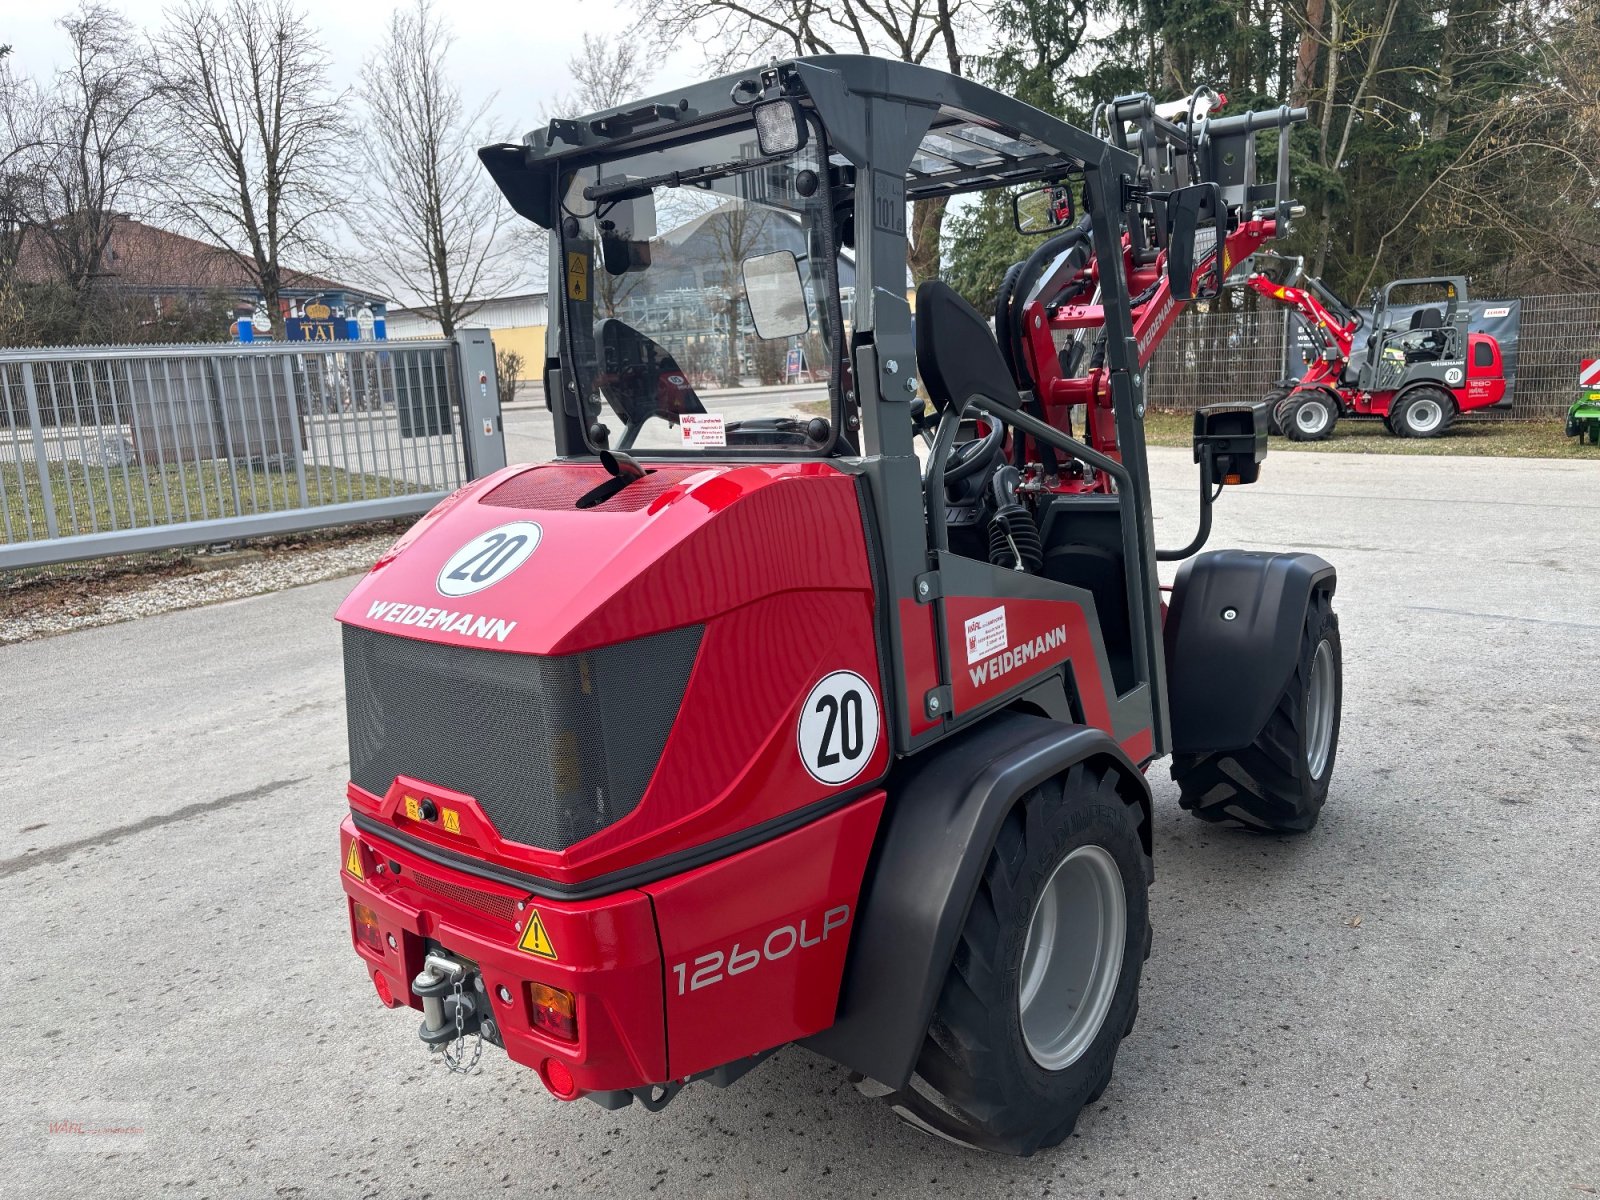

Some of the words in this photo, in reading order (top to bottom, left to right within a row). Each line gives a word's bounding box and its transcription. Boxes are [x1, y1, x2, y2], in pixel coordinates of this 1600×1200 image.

[877, 196, 894, 230] 101
[300, 325, 335, 343] TAJ
[1137, 294, 1175, 356] WEIDEMAN
[1448, 371, 1459, 381] 20
[446, 532, 528, 583] 20
[366, 600, 517, 643] WEIDEMANN
[968, 623, 1067, 688] WEIDEMANN
[816, 689, 863, 767] 20
[672, 904, 850, 996] 1260LP
